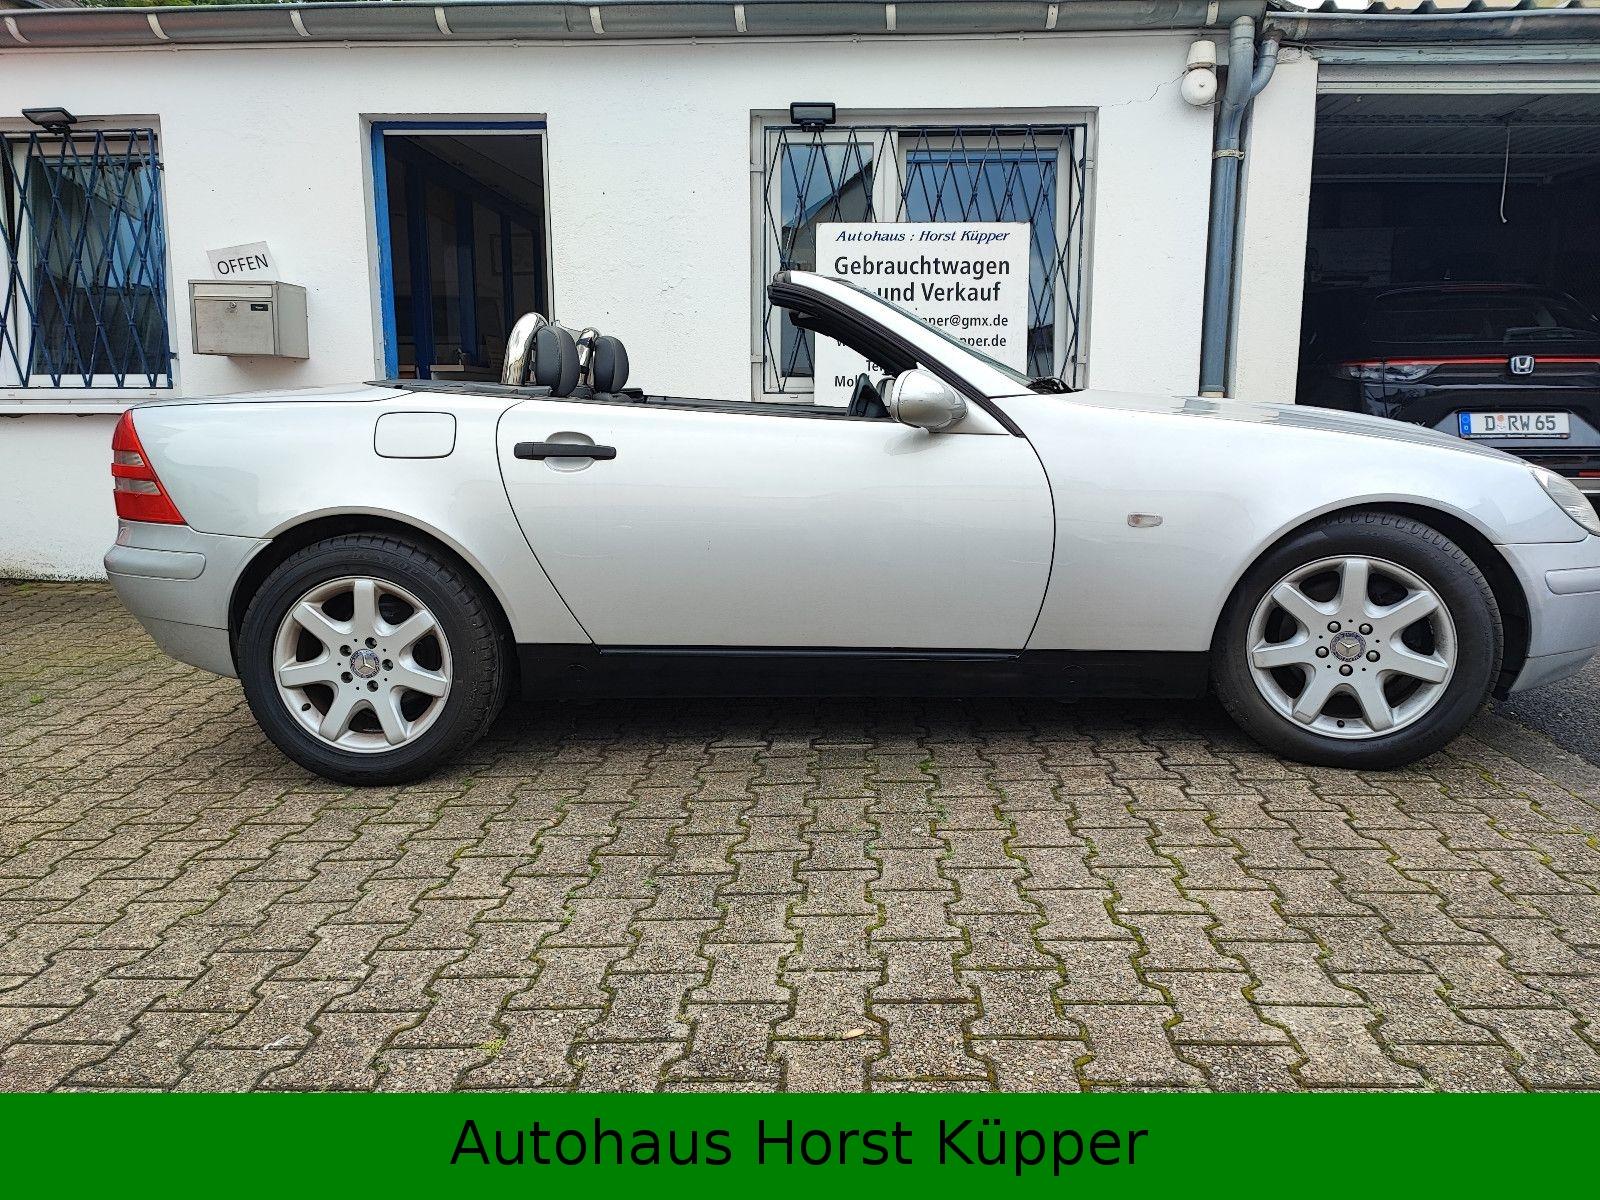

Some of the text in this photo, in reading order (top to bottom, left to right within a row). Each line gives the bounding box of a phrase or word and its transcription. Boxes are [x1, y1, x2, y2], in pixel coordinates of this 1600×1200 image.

[835, 230, 906, 242] Autohaus
[918, 230, 957, 242] Horst
[960, 230, 1010, 245] Küpper
[217, 253, 269, 275] OFFEN
[834, 255, 1011, 280] Gebrauchtwagen
[877, 281, 1002, 302] und Verkauf
[1484, 415, 1557, 431] D RW 65
